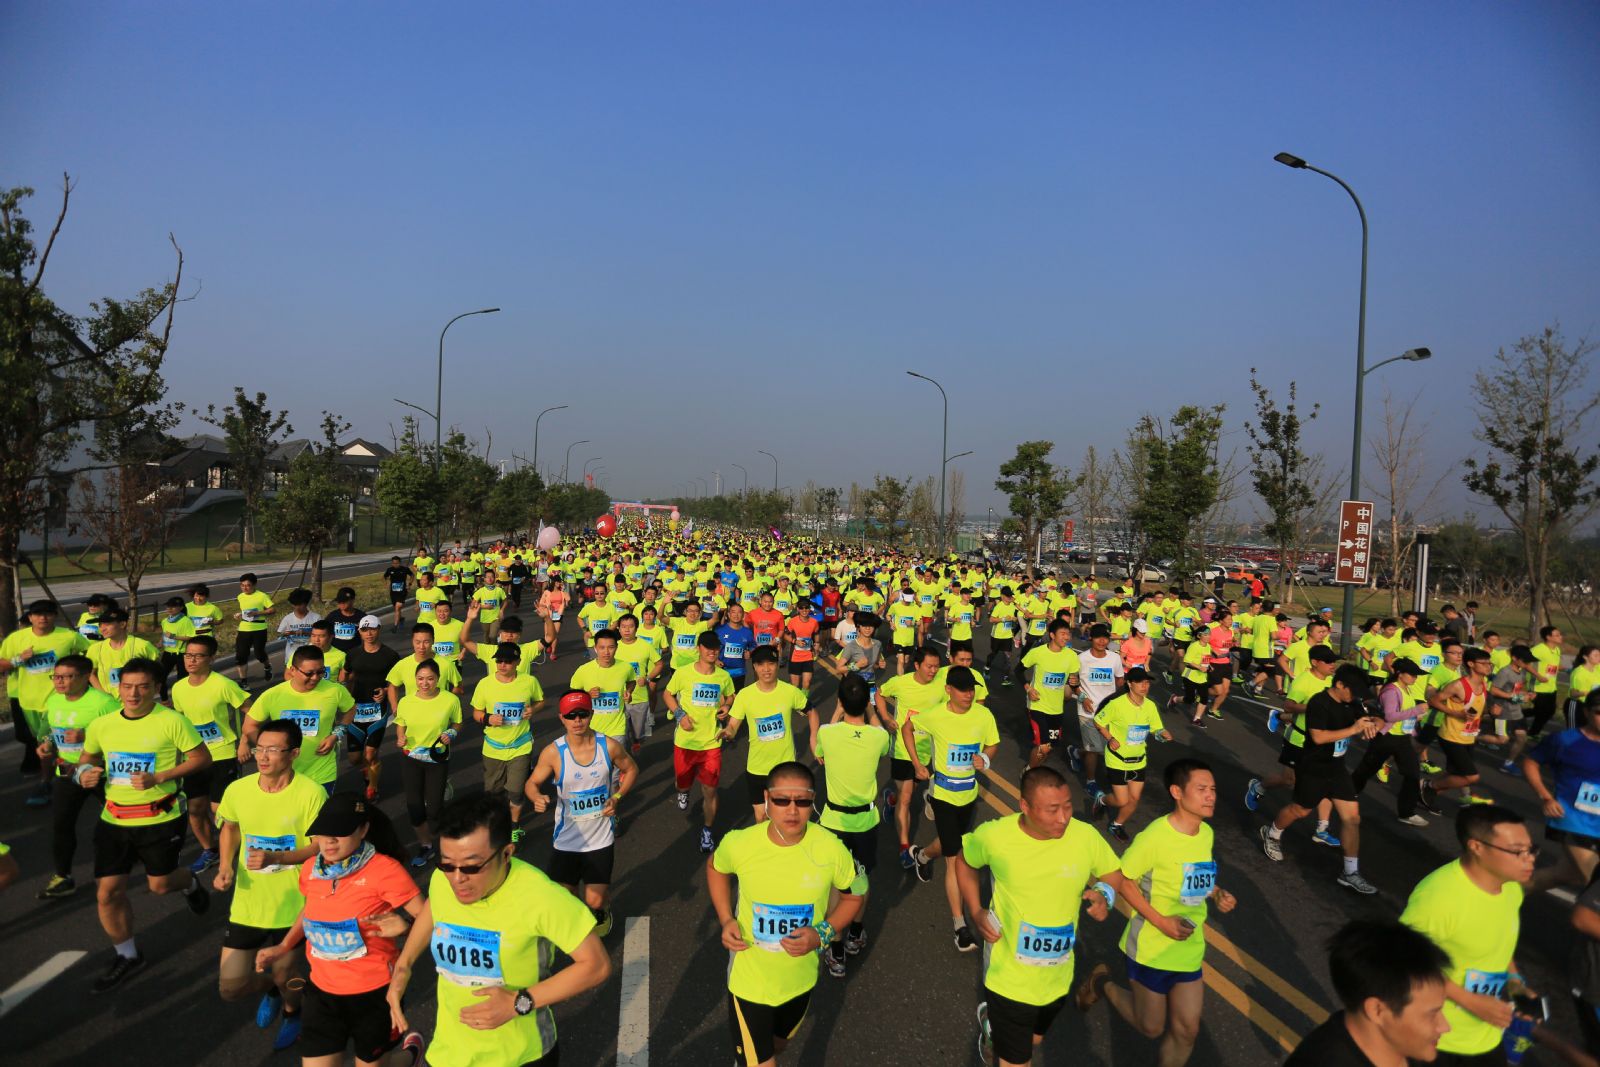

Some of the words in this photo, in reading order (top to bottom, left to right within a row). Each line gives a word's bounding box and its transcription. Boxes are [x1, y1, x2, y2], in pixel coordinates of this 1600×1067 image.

[1343, 521, 1349, 530] P
[1353, 507, 1370, 579] 中国花博园
[693, 688, 717, 699] 10233
[592, 698, 617, 707] 11962
[495, 708, 522, 718] 11807
[757, 719, 782, 734] 10832
[110, 761, 151, 773] 10257
[573, 793, 606, 811] 10466
[436, 942, 495, 969] 10185
